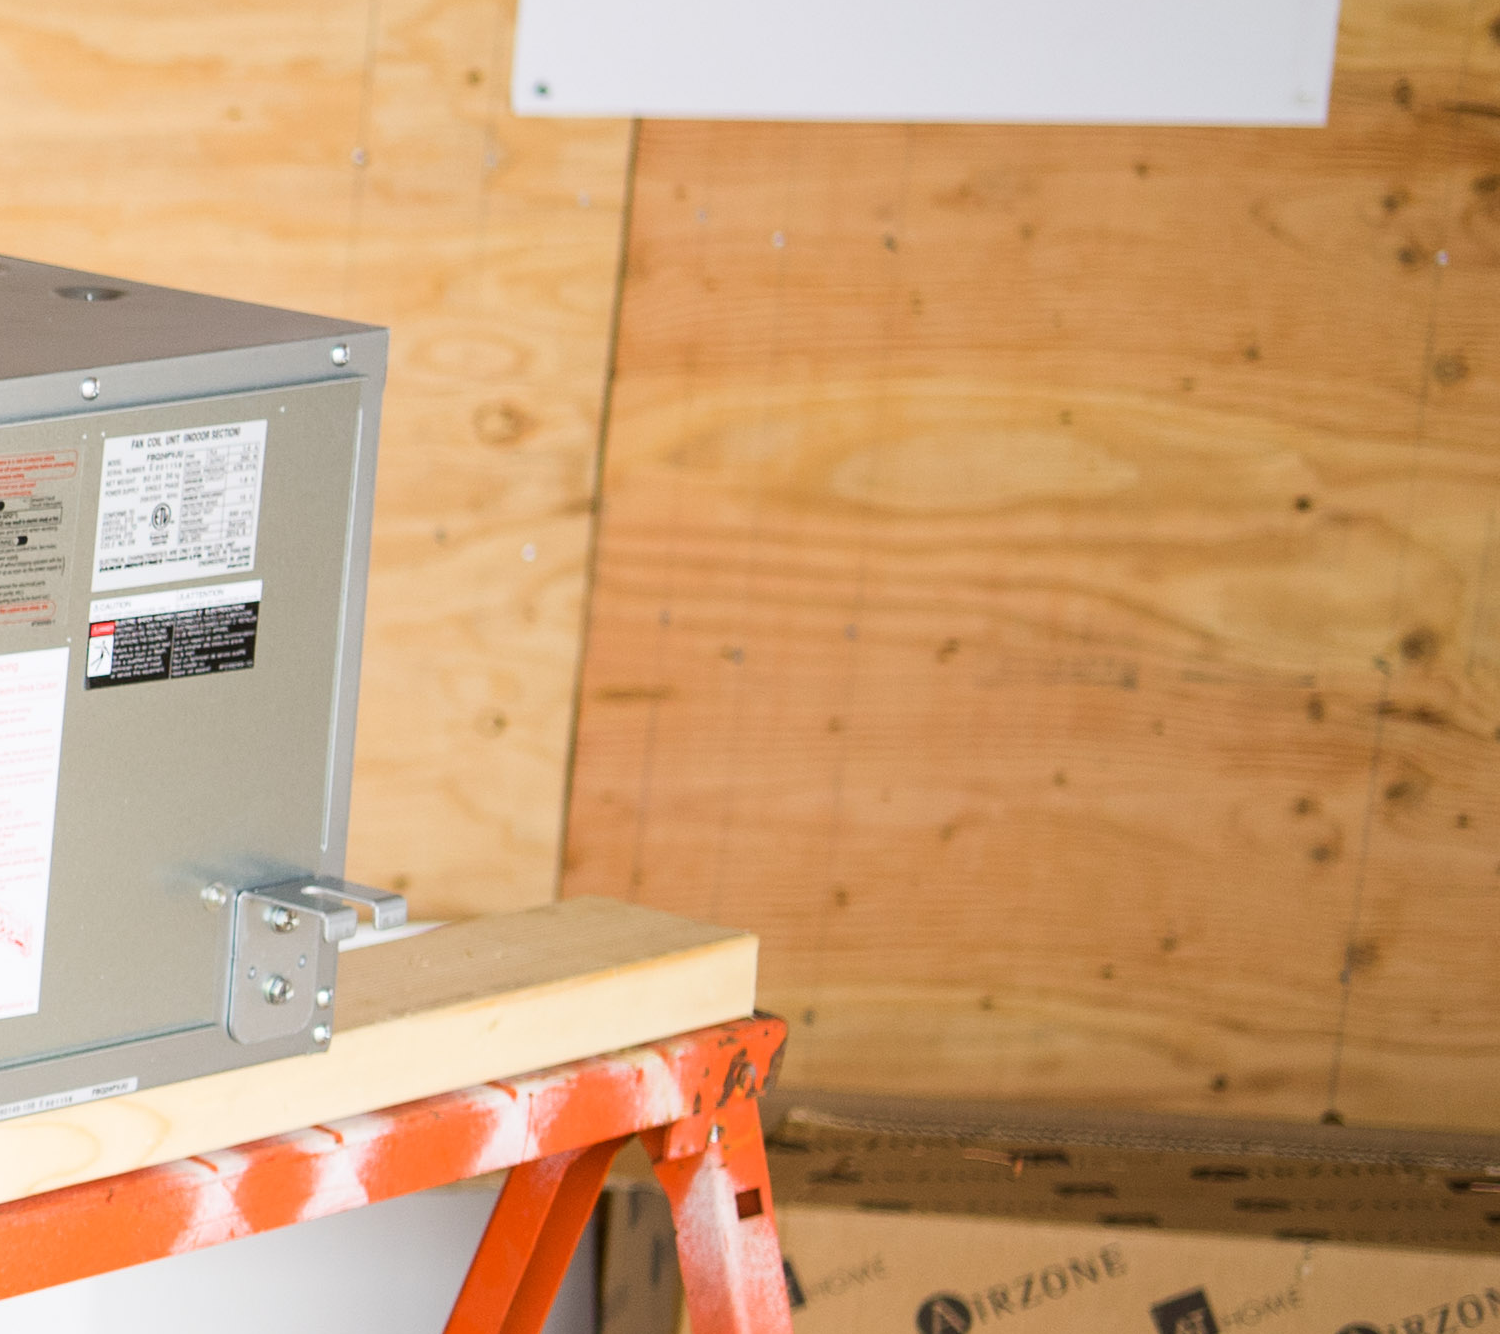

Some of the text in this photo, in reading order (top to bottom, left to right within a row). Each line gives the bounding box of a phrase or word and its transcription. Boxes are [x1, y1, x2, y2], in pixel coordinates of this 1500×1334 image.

[131, 439, 143, 449] FAN
[147, 437, 161, 447] COIL
[166, 434, 180, 445] UNIT
[1220, 1284, 1305, 1332] HOME
